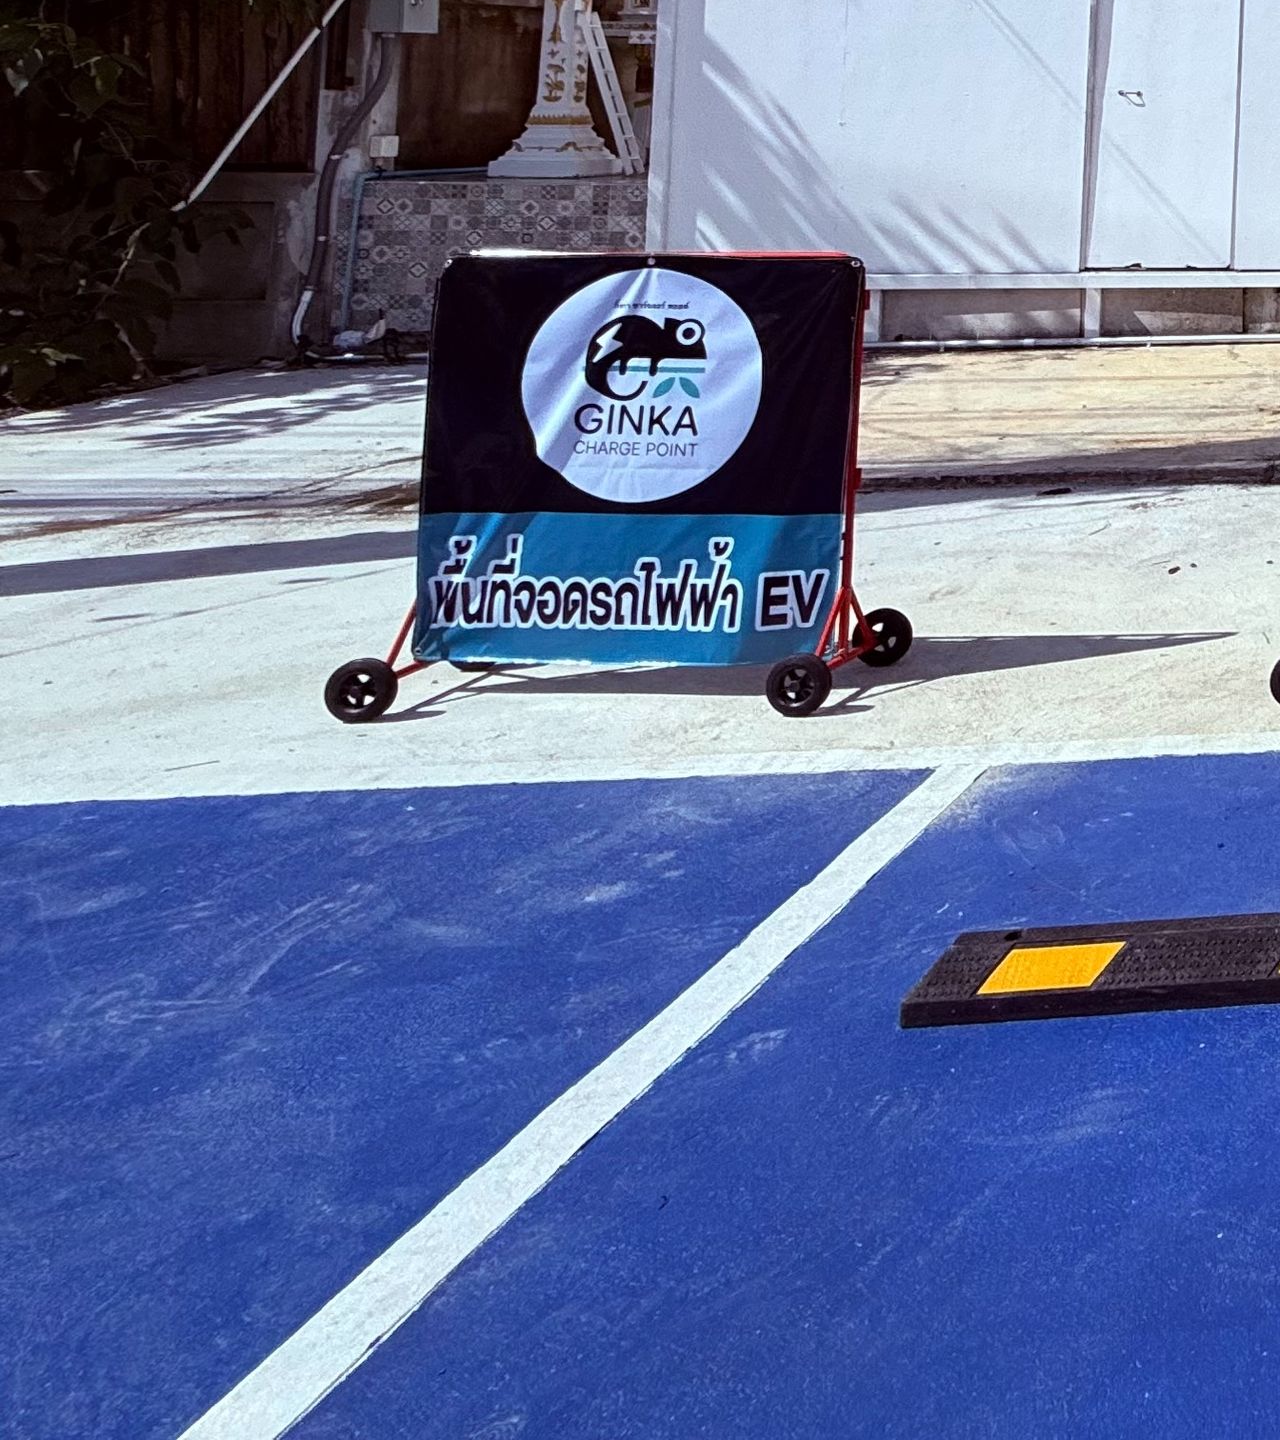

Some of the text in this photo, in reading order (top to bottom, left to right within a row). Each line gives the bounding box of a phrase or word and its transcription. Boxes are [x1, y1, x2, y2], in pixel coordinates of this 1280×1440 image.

[573, 403, 699, 437] GINKA
[572, 439, 699, 457] CHARGE POINT
[430, 536, 827, 629] พื้นที่จอดรถไฟฟ้า EV
